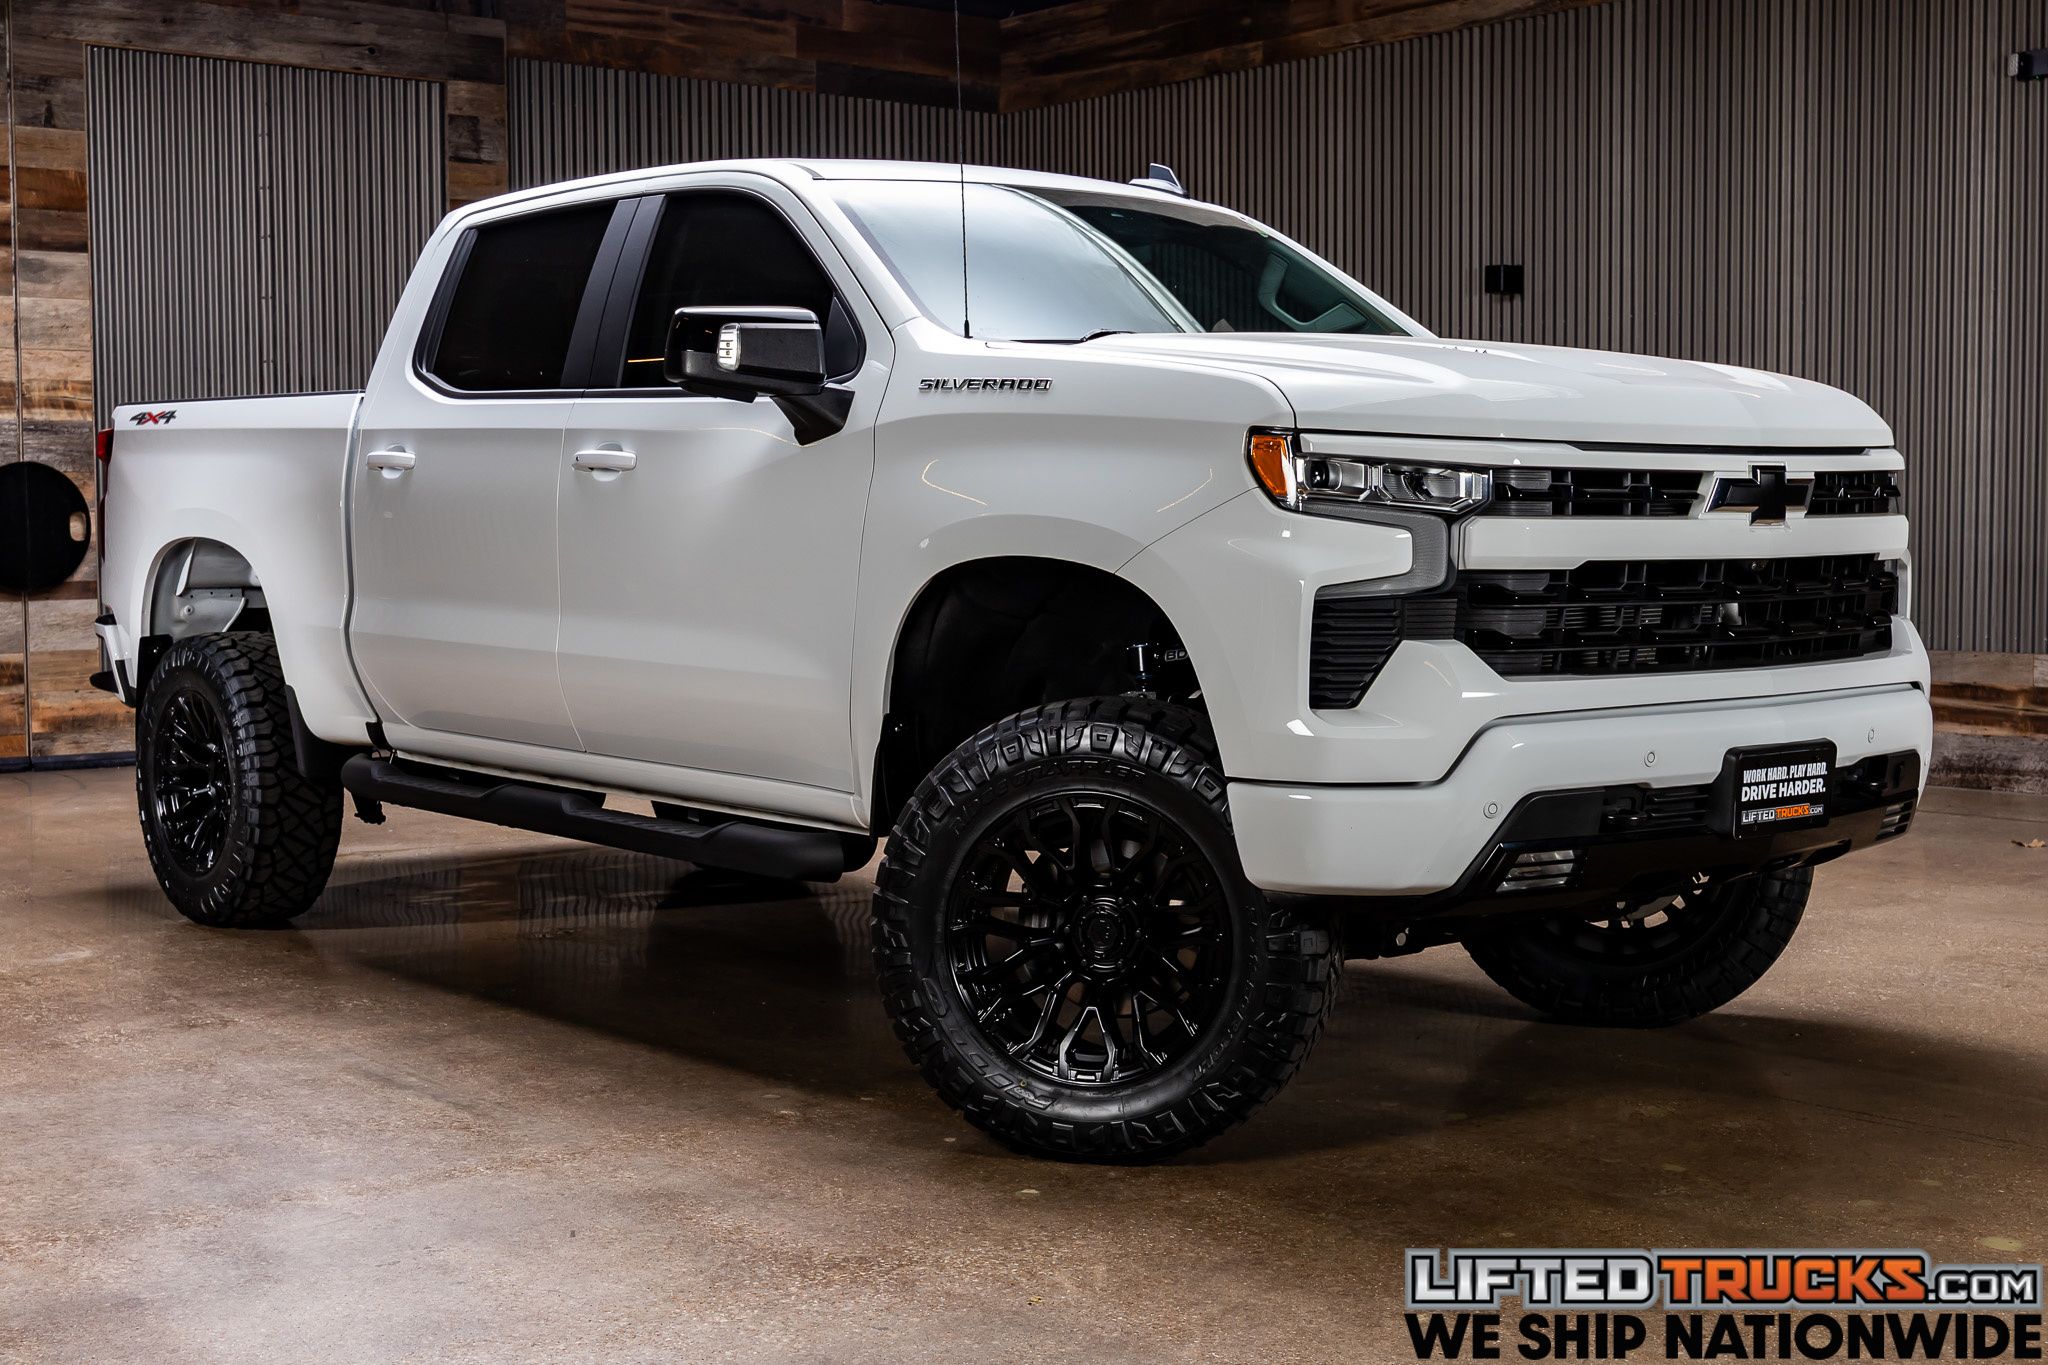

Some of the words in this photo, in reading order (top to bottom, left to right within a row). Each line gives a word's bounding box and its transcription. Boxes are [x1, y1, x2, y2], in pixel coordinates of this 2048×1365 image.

[918, 377, 1053, 393] SILVERADO
[1743, 768, 1767, 784] WORK
[1767, 766, 1789, 781] HARD.
[1789, 764, 1807, 779] PLAY
[1807, 762, 1828, 776] HARD.
[1741, 783, 1777, 802] DRIVE
[1778, 778, 1826, 798] HARDER.
